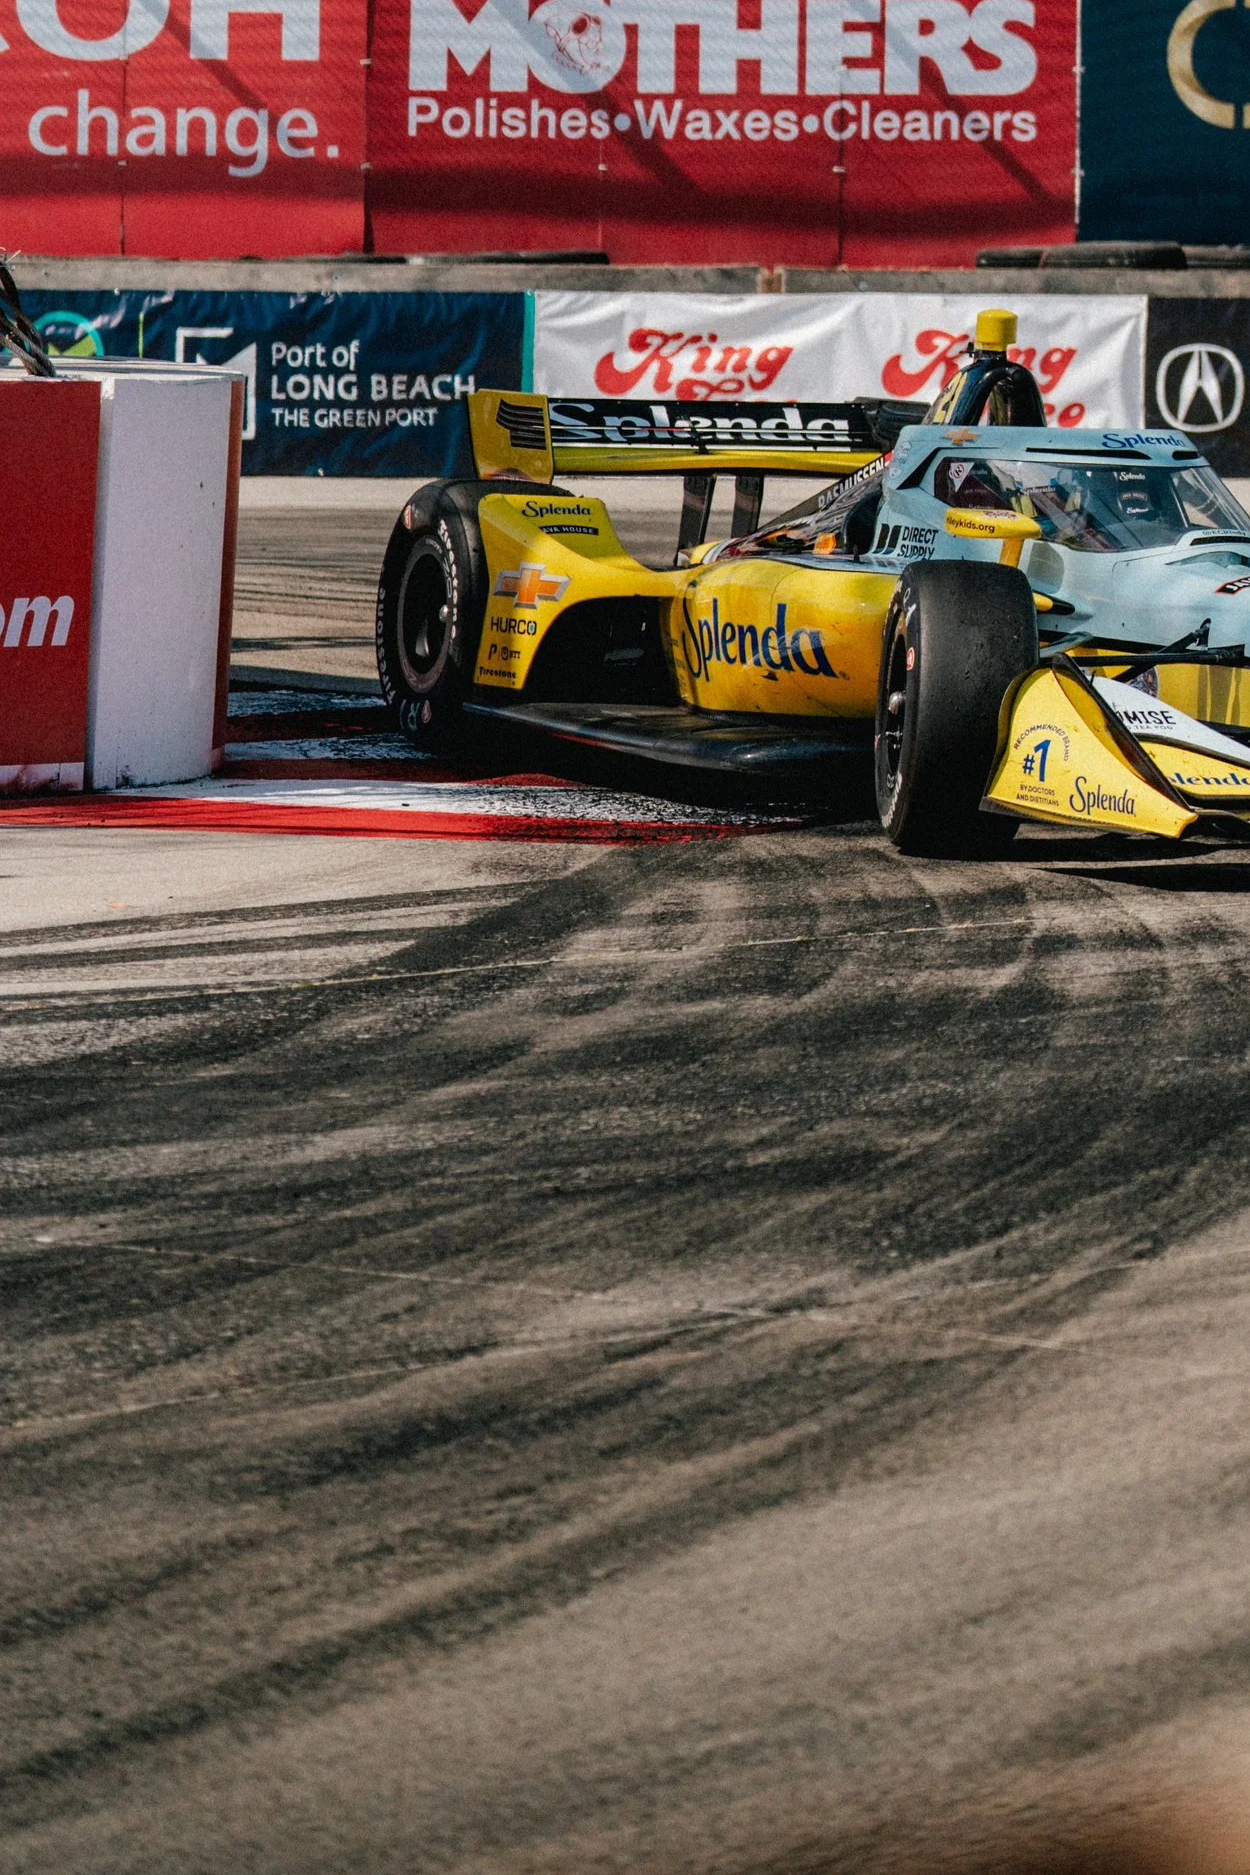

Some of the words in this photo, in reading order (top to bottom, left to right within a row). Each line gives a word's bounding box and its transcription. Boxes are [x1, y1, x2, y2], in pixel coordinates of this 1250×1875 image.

[28, 88, 339, 178] change.
[271, 341, 327, 368] Port
[332, 339, 360, 371] of
[593, 327, 794, 396] King
[881, 329, 1077, 397] Kng
[271, 374, 358, 401] LONG
[370, 373, 476, 402] BEACH
[271, 408, 310, 428] THE
[314, 408, 381, 429] GREEN
[385, 406, 438, 427] PORT
[550, 403, 851, 443] Splenda
[1101, 433, 1187, 449] Splenda
[522, 501, 591, 518] Splenda
[542, 526, 560, 534] AVA
[562, 526, 595, 534] HOUSE
[901, 525, 938, 543] DIRECT
[490, 616, 537, 636] HURCO
[682, 580, 839, 682] Splenda
[478, 666, 517, 679] Firestone
[1013, 724, 1066, 751] RECOMMENDED
[1061, 736, 1071, 762] BRAND
[1016, 793, 1029, 802] AND
[1029, 795, 1059, 807] DIETITIANS
[1020, 784, 1028, 792] BY
[1028, 785, 1055, 797] DOCTORS
[1069, 776, 1136, 815] Splenda
